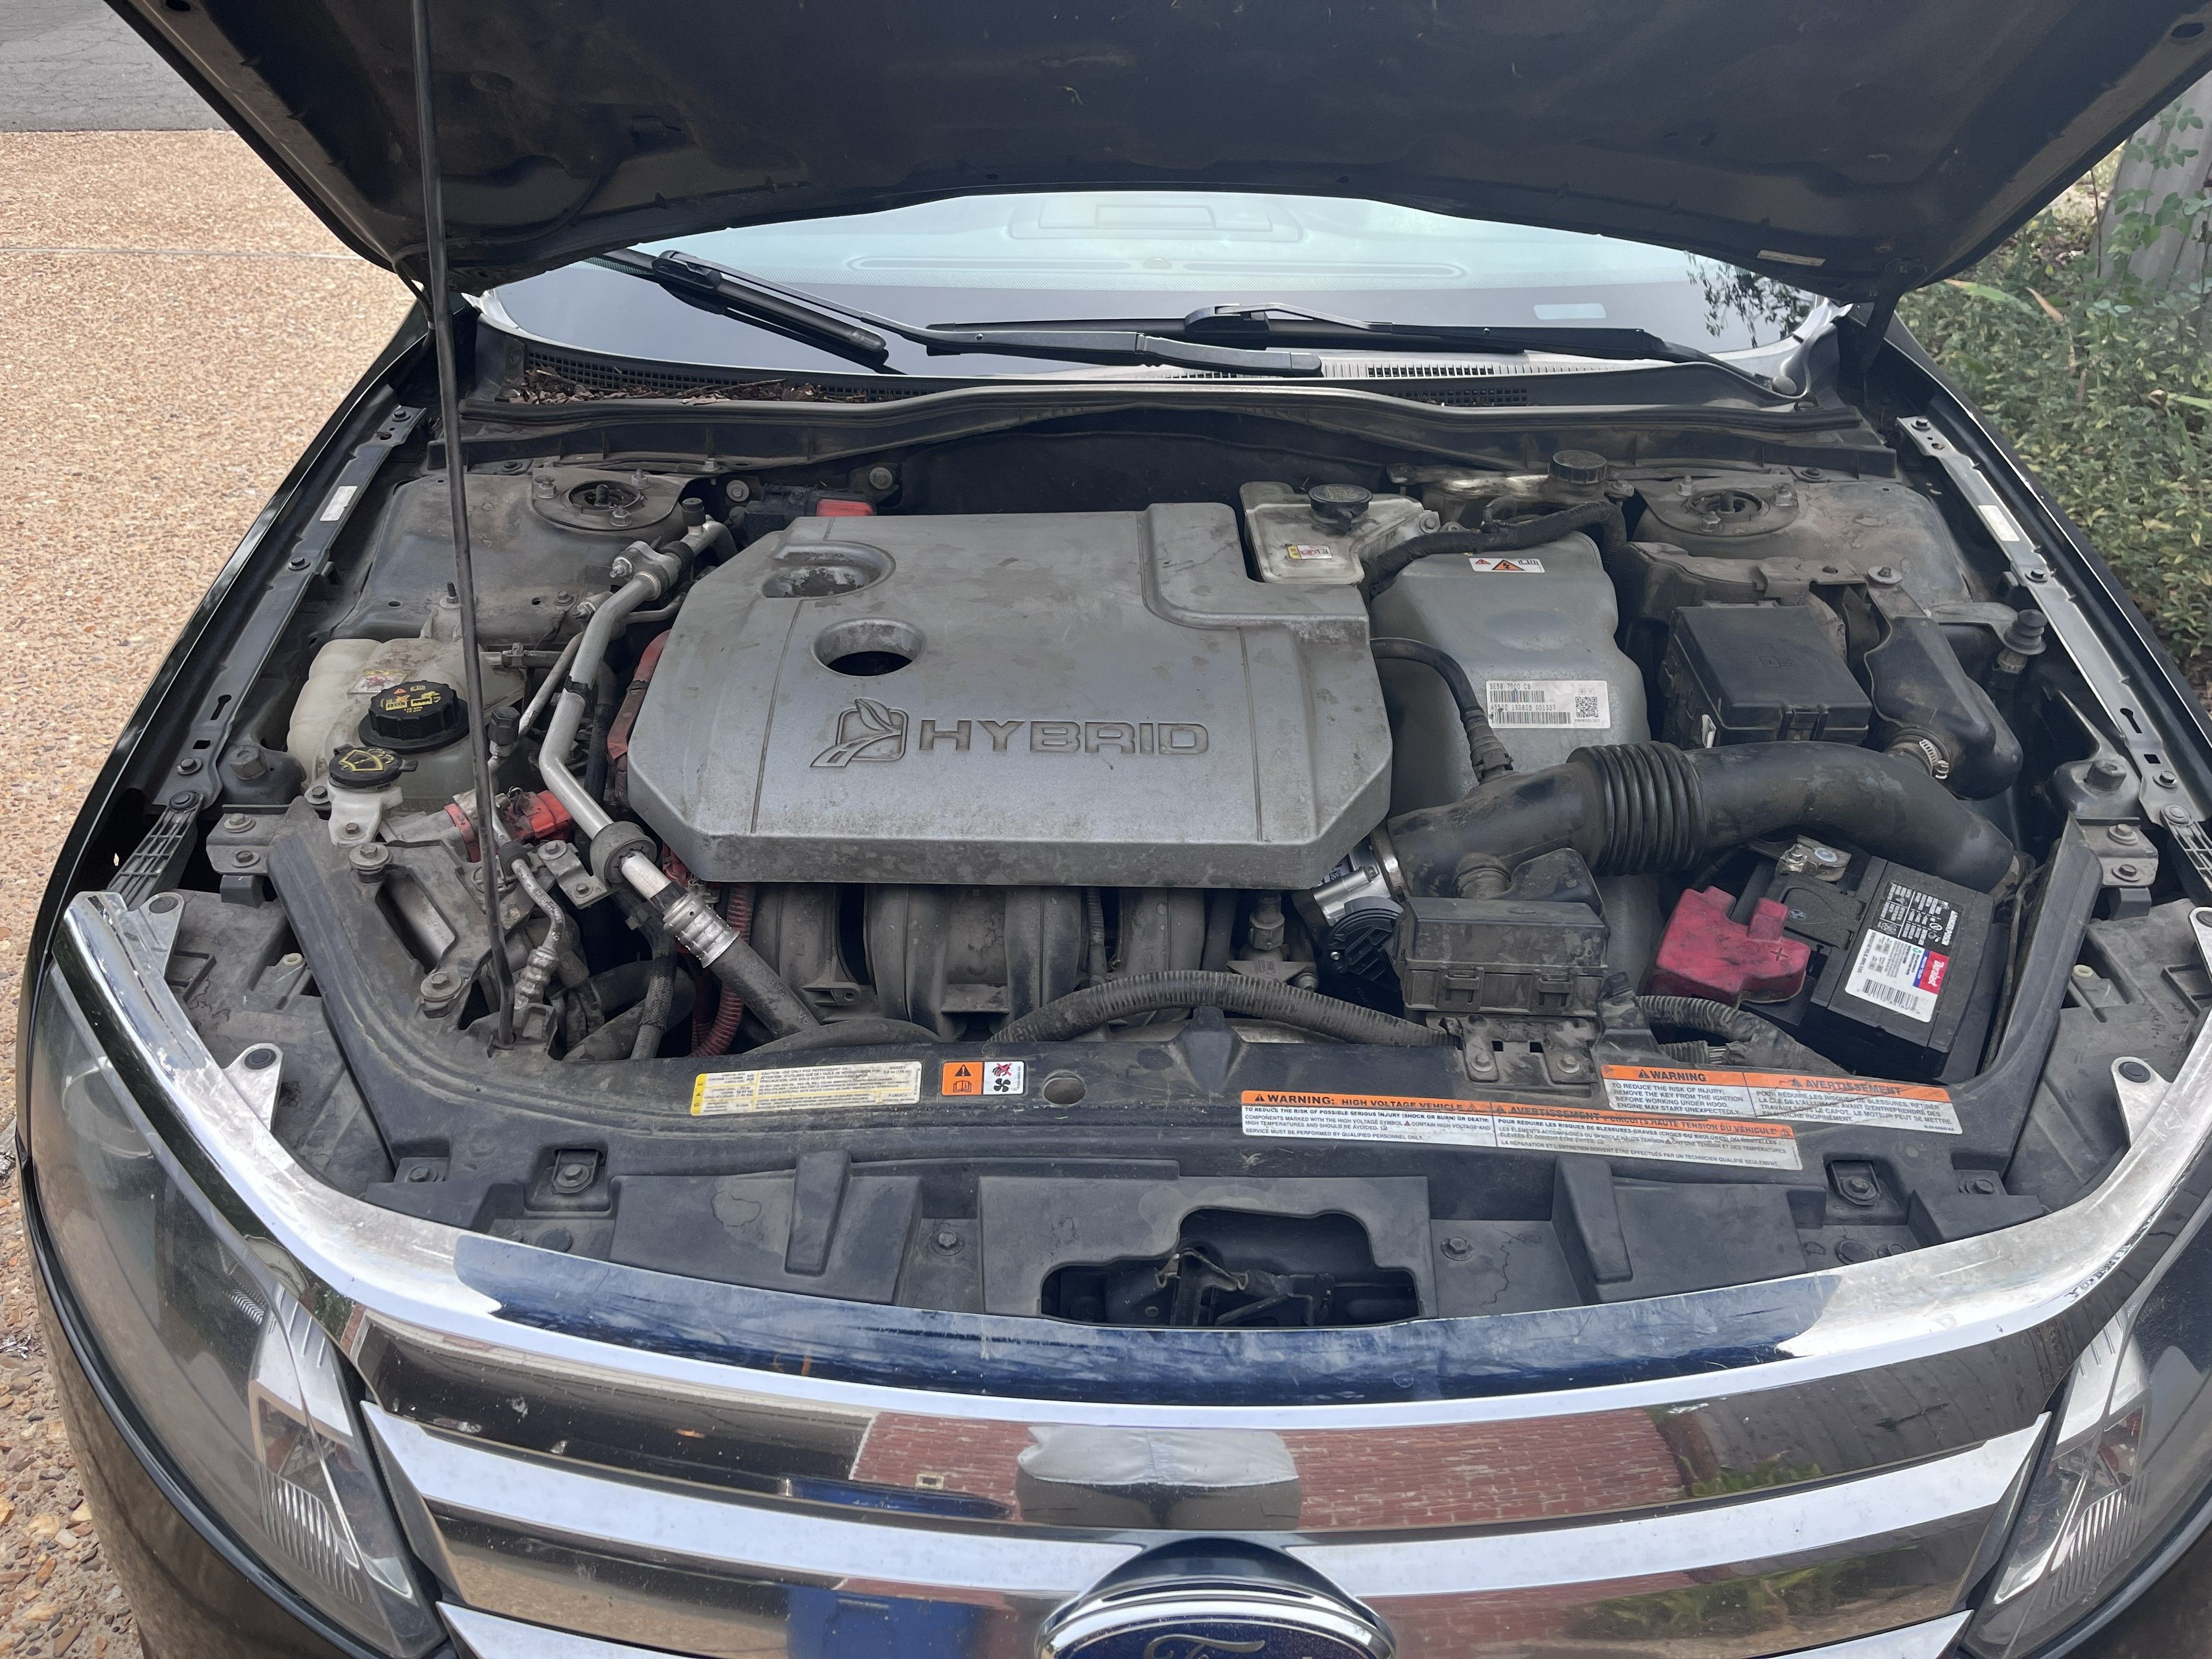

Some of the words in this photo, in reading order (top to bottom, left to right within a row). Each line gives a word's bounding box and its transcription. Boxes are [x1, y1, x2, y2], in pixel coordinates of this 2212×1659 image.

[919, 719, 1208, 755] HYBRID
[1927, 960, 1945, 987] Duralast
[1650, 1070, 1707, 1082] WARNING
[1804, 1079, 1903, 1095] AVERTISSEMENT
[1267, 1094, 1334, 1105] WARNING:
[1370, 1100, 1417, 1108] VOLTAGE
[1651, 1119, 1678, 1127] HAUTE
[1680, 1121, 1718, 1130] TENSION
